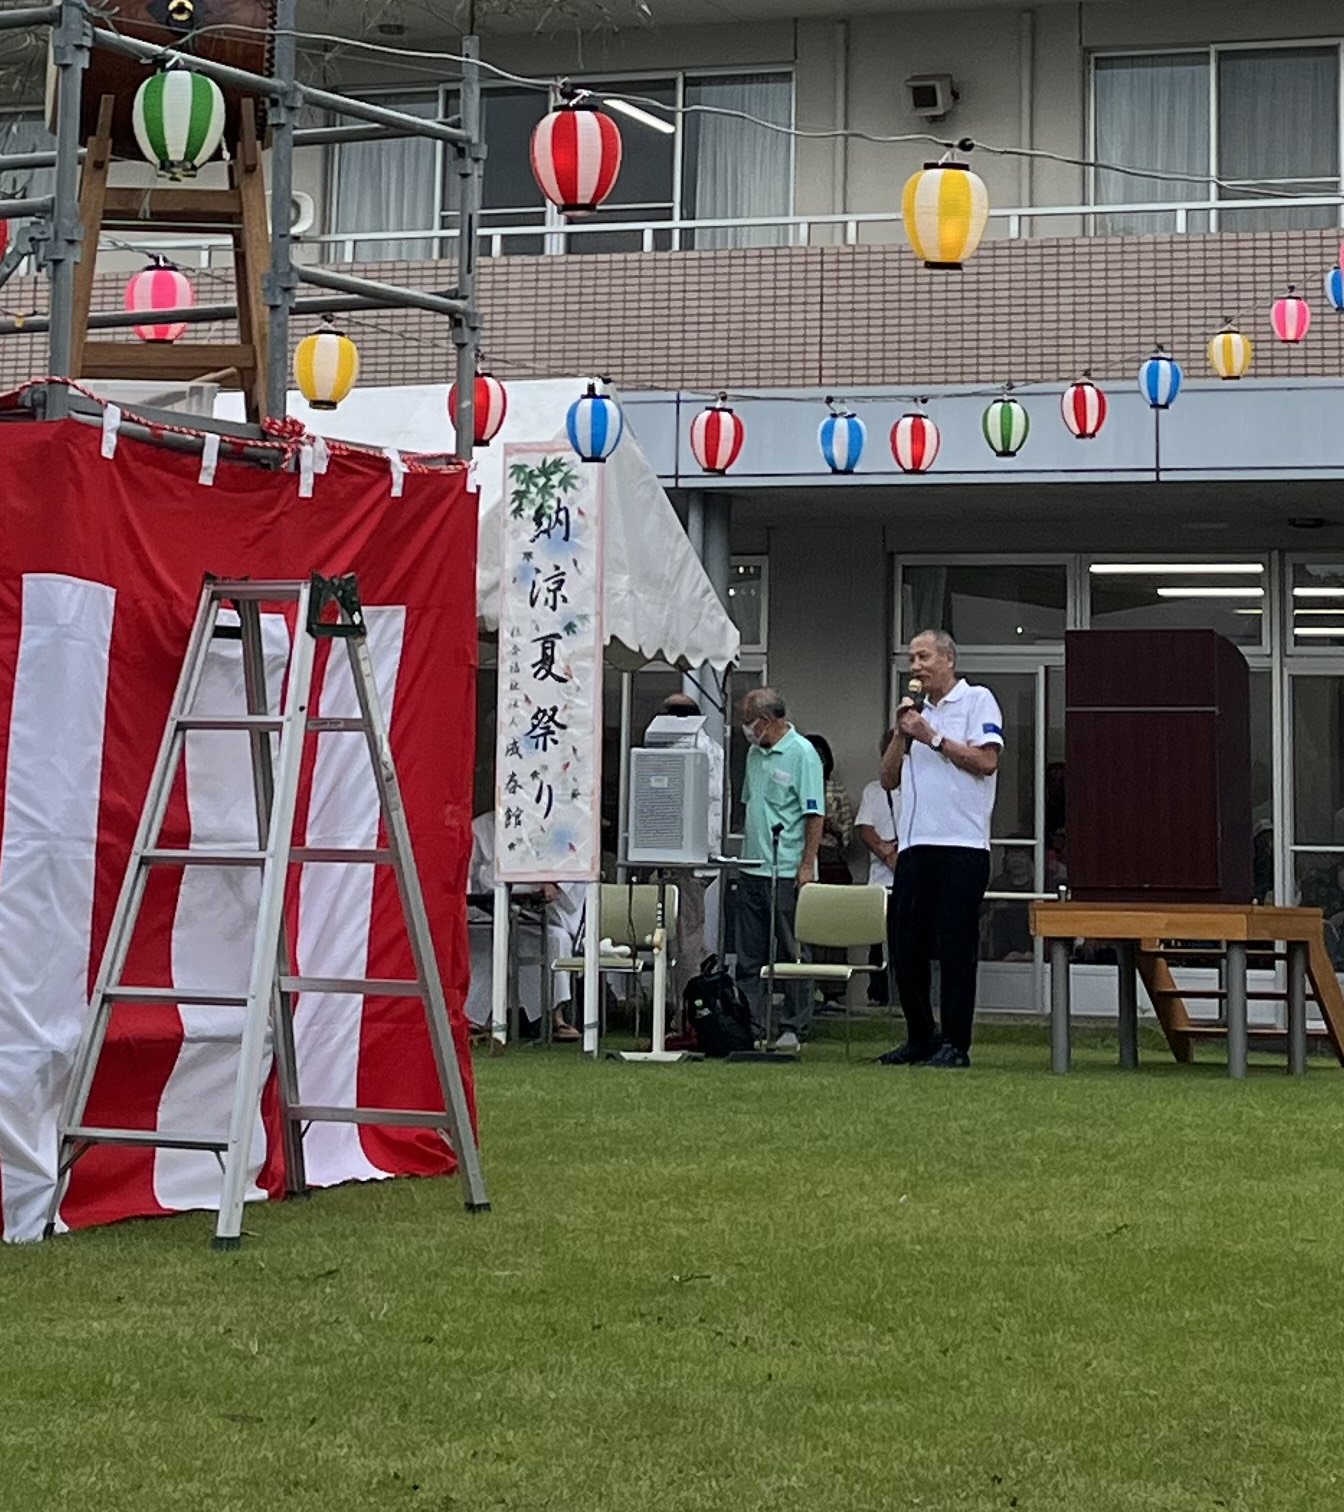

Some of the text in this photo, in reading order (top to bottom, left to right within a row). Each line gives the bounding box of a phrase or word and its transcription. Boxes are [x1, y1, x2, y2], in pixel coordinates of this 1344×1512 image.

[524, 497, 570, 820] 納涼夏祭り
